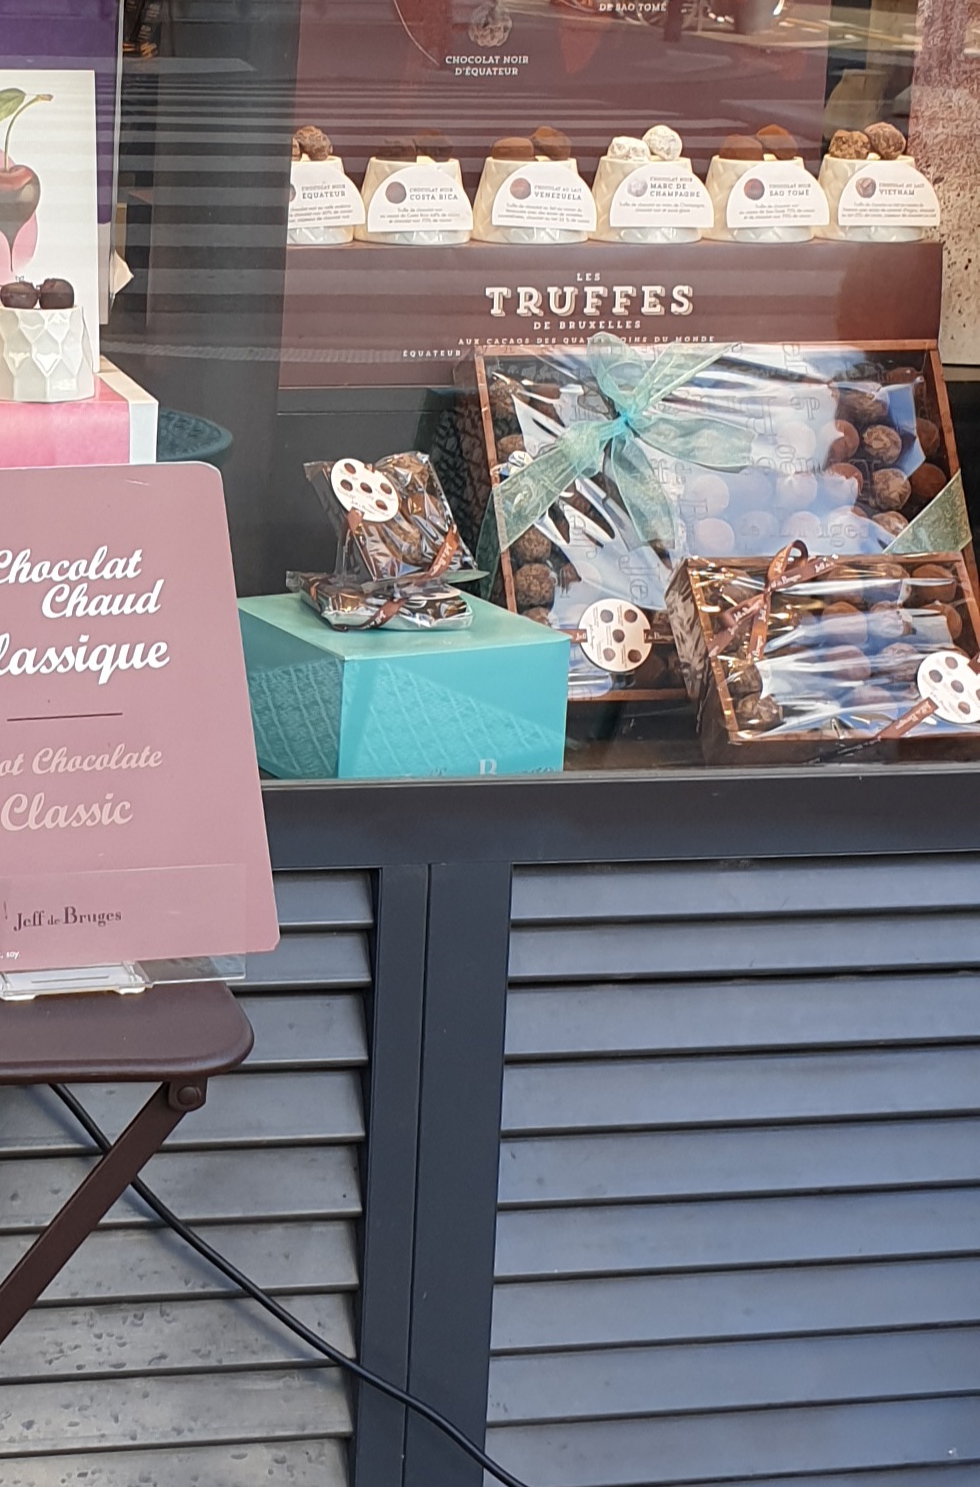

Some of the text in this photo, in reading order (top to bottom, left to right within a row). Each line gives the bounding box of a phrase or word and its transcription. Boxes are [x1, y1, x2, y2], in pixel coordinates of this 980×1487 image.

[445, 56, 529, 65] CHOCOLAT NOIR
[455, 66, 518, 76] D'ÉQUATEUR
[534, 191, 582, 201] VENEZUELA
[576, 272, 601, 282] LES
[485, 284, 694, 318] TRUFFES
[533, 319, 642, 330] DE BRUXELLES
[458, 335, 715, 346] AUX CACAOS DES DU MONDE
[402, 349, 462, 358] ÉQUATEUR
[40, 579, 165, 620] Chaud
[32, 742, 164, 775] Chocolate
[0, 791, 133, 832] Classic
[12, 906, 123, 932] Jeff de Bruges
[6, 950, 20, 959] soy.
